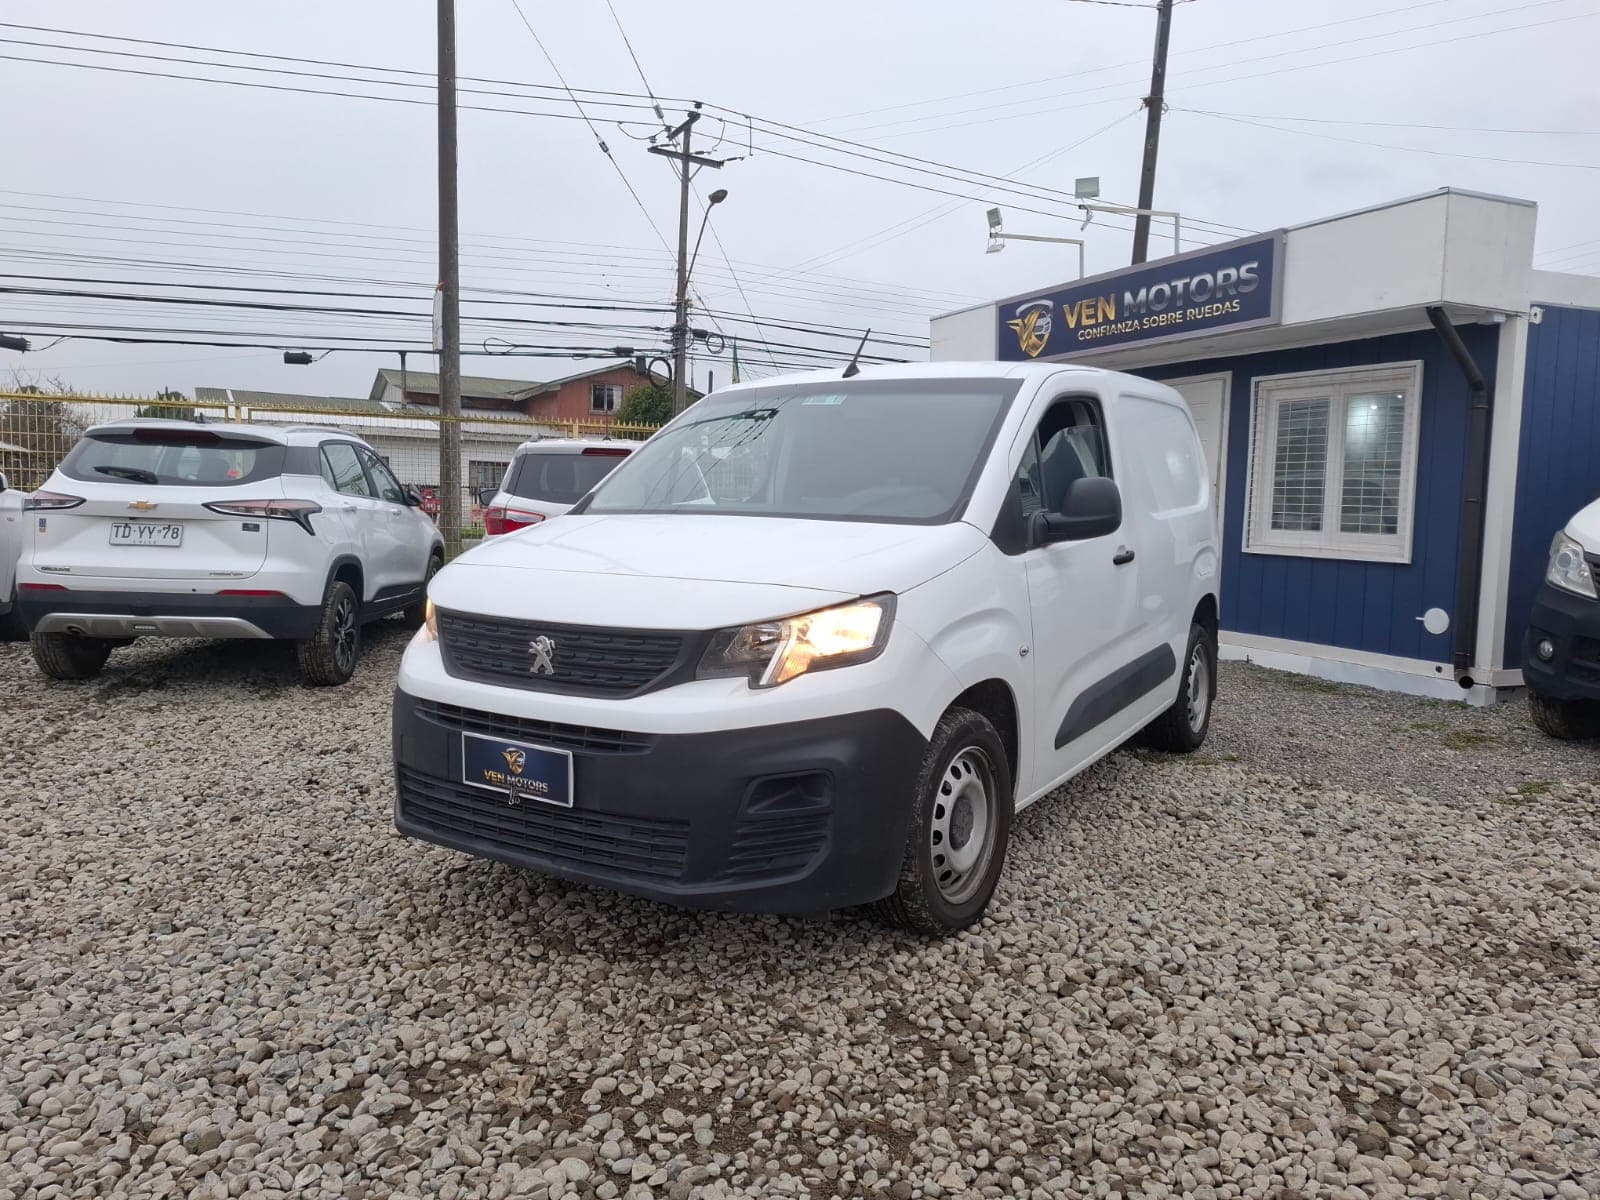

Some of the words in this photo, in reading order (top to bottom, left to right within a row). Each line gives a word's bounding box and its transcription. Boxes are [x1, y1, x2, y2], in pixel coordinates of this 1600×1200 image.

[1063, 293, 1116, 329] VEN
[1123, 260, 1260, 318] MOTORS
[1077, 321, 1141, 342] CONFIANZA
[1142, 310, 1184, 330] SOBRE
[1186, 299, 1242, 320] RUEDAS
[484, 769, 505, 783] VEN
[506, 774, 549, 793] MOTORS
